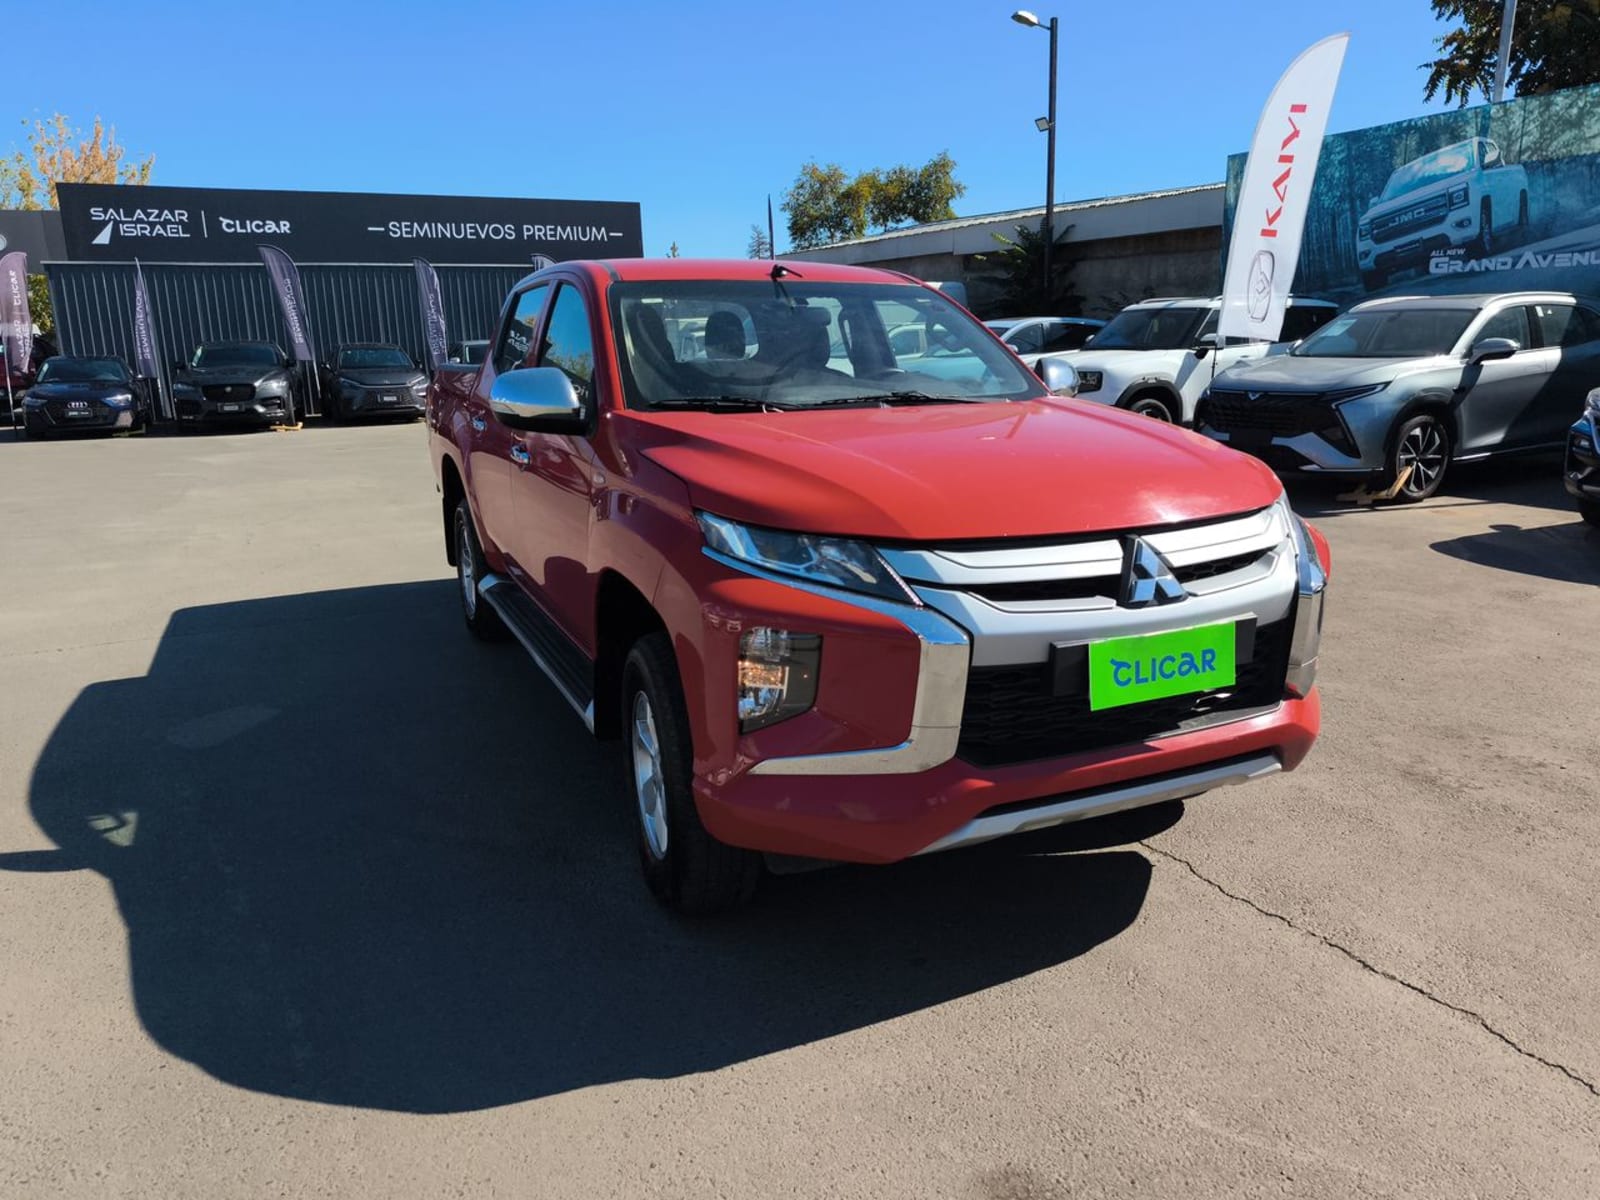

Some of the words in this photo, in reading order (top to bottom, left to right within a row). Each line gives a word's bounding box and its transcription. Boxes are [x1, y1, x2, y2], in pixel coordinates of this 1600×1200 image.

[1260, 104, 1307, 238] KAIYI
[90, 207, 189, 223] SALAZAR
[1389, 208, 1425, 227] JMC
[119, 223, 191, 237] ISRAEL
[388, 221, 516, 240] SEMINUEVOS
[523, 224, 608, 242] PREMIUM
[1430, 249, 1445, 257] ALL
[1446, 247, 1467, 256] NEW
[1429, 256, 1513, 275] GRAND
[1110, 648, 1216, 688] CLICAR
